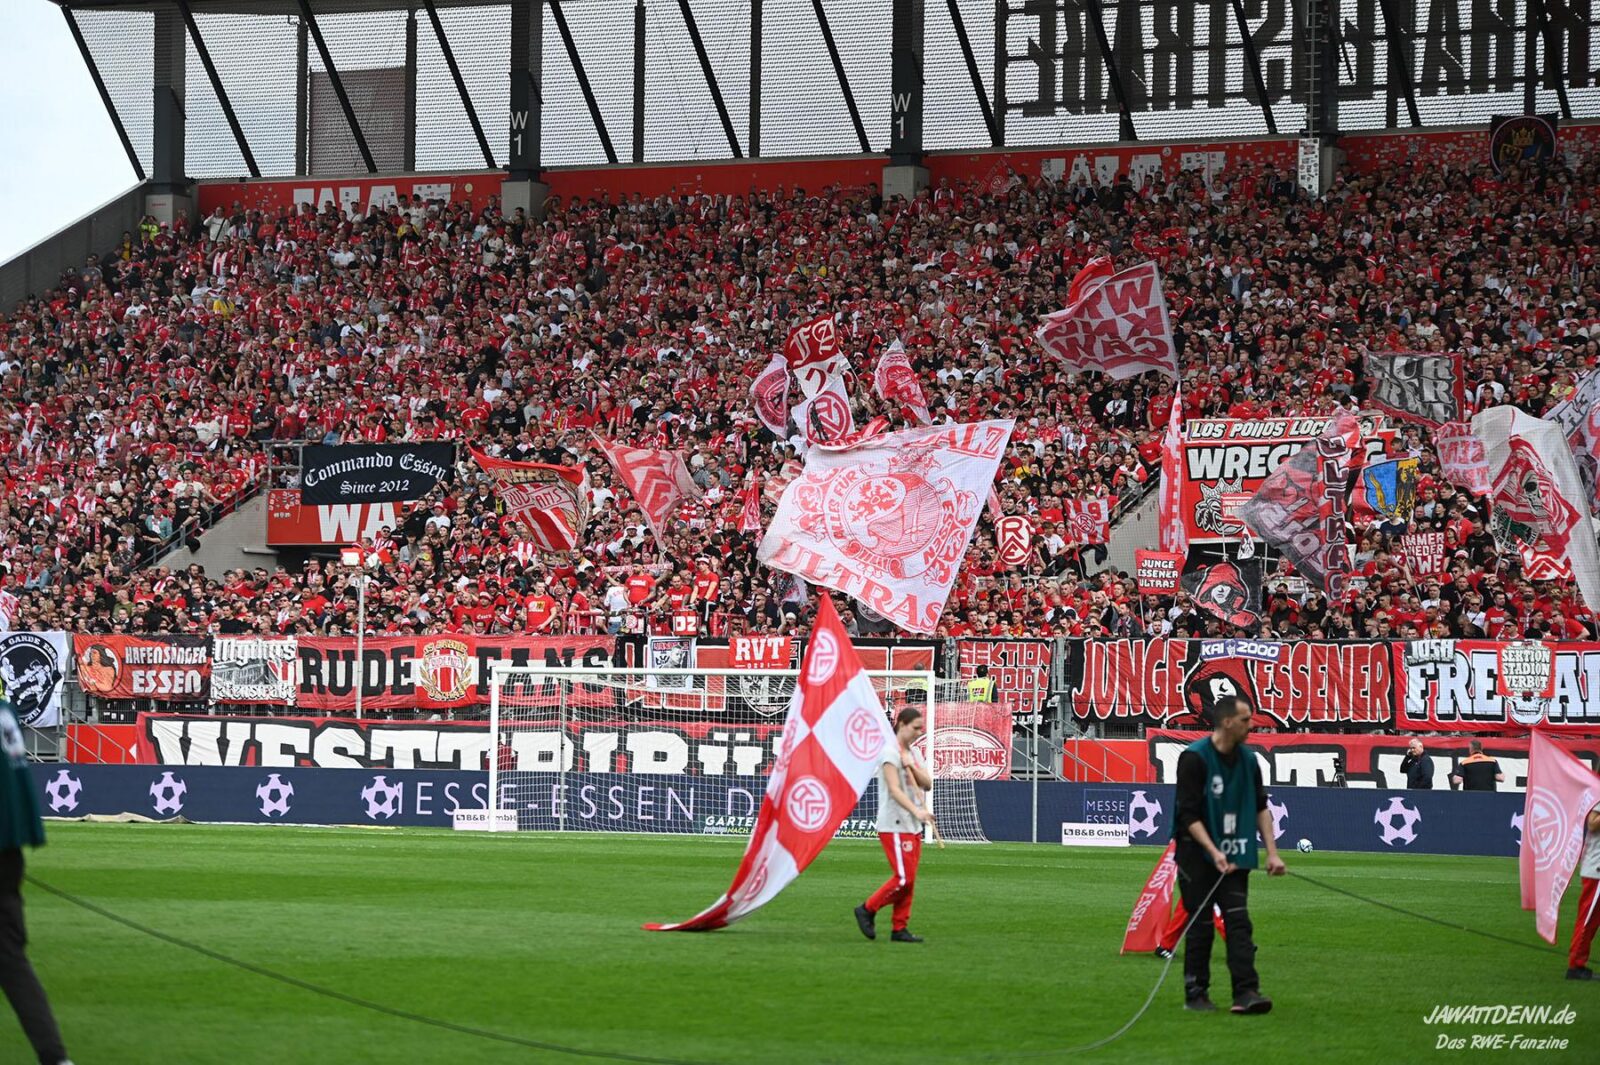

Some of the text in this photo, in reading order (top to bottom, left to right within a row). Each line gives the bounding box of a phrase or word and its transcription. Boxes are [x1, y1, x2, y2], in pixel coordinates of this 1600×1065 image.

[892, 93, 911, 112] W
[510, 111, 528, 129] W
[896, 116, 904, 139] 1
[513, 134, 522, 155] 1
[1190, 420, 1225, 439] LOS
[304, 452, 447, 487] Commando Essen
[340, 479, 410, 495] Since 2012
[1141, 559, 1175, 569] JUNGE
[1139, 578, 1175, 588] ULTRAS
[735, 637, 785, 661] RVT
[1201, 642, 1280, 660] KAI 2000
[300, 646, 415, 697] RUDE
[1502, 662, 1551, 677] STADION
[132, 670, 201, 694] ESSEN
[1072, 637, 1392, 722] JUNGE ESSENER
[1504, 675, 1549, 690] VERBOT
[1086, 800, 1125, 812] MESSE
[1075, 829, 1128, 837] B&B GmbH
